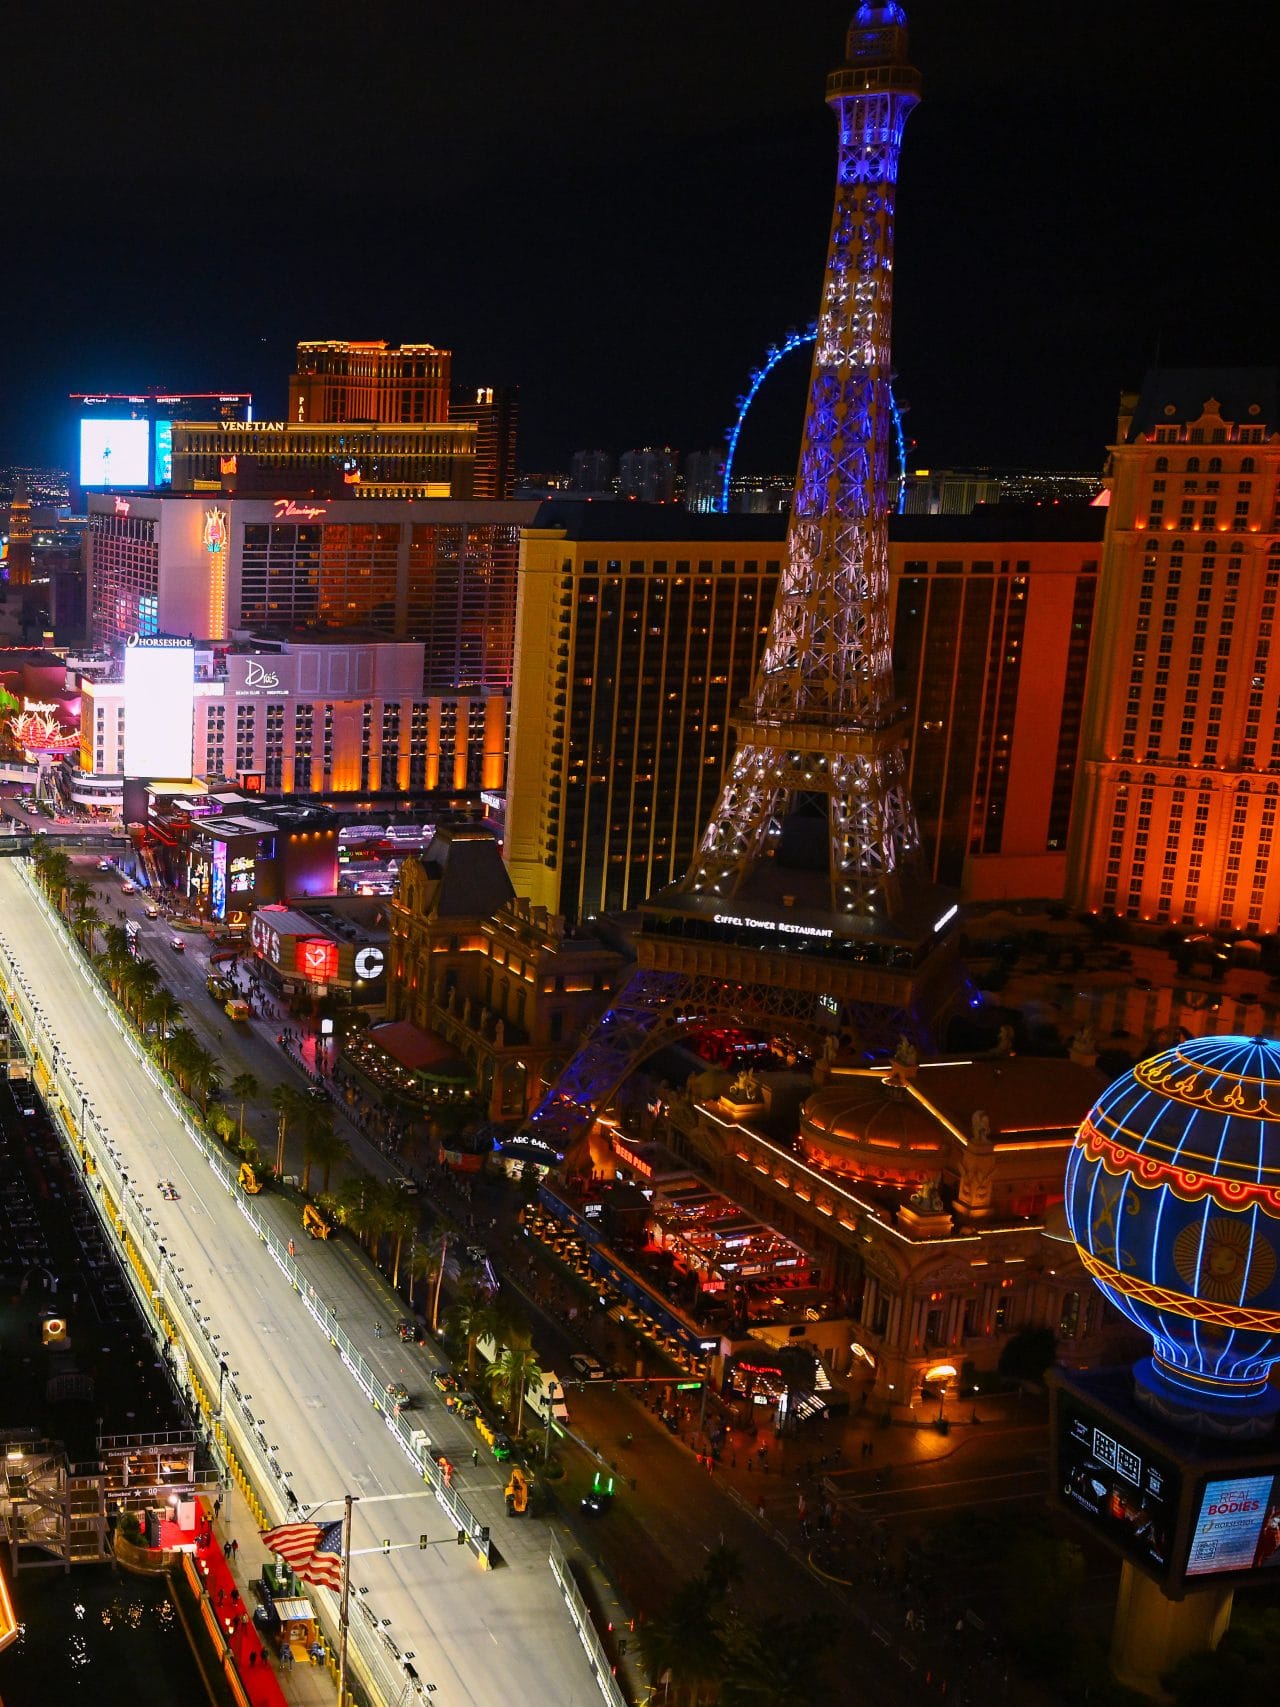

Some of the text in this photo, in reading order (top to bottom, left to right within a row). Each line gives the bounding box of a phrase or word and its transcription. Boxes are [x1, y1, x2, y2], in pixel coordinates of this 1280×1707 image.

[221, 421, 284, 431] VENETIAN
[274, 499, 326, 519] Flamingo
[139, 638, 193, 647] HORSESHOE
[245, 659, 280, 688] Drai's
[713, 914, 833, 938] EIFFEL TOWER RESTAURANT
[615, 1143, 652, 1177] BEER PARK
[1220, 1490, 1250, 1503] REAL
[1208, 1500, 1260, 1516] BODIES
